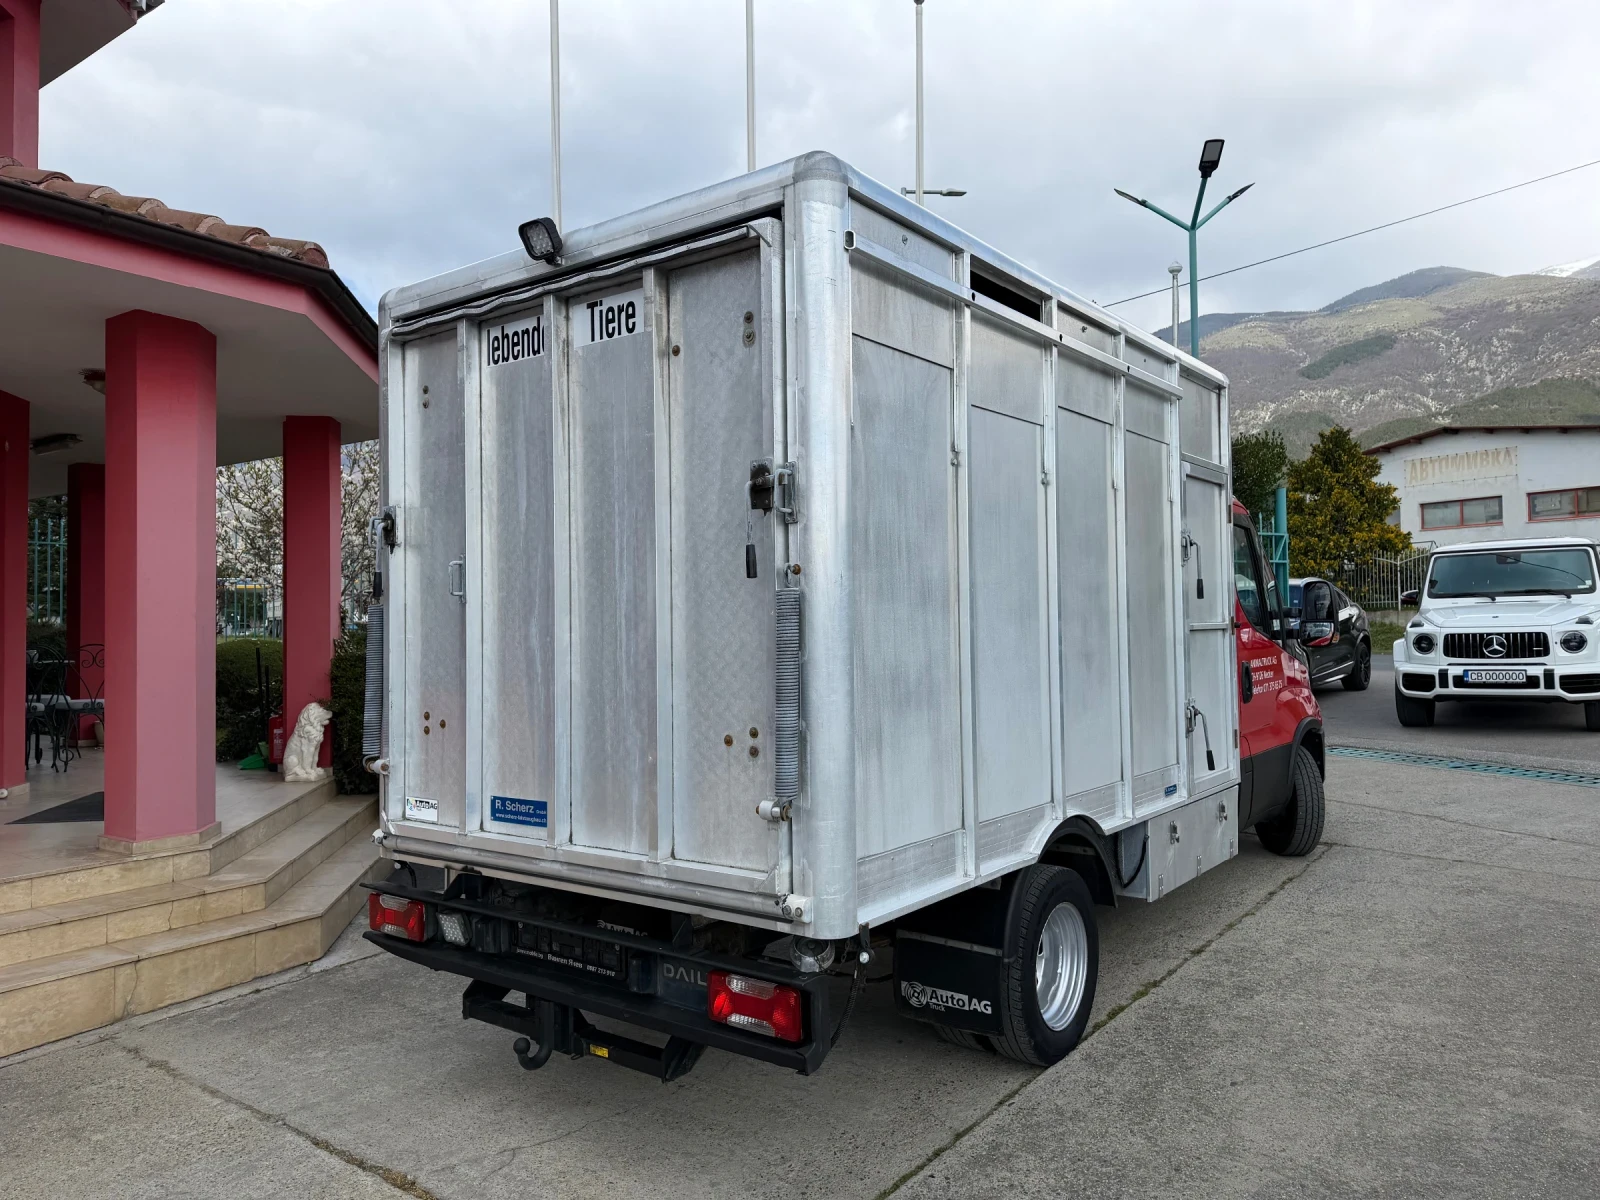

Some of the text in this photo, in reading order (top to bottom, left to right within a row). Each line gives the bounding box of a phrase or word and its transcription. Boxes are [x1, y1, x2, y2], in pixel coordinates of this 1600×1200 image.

[487, 300, 637, 367] lebend Tiere
[1408, 448, 1514, 485] АВТОМИВКА
[495, 799, 504, 809] R.
[505, 800, 535, 813] Scherz
[663, 962, 708, 986] DAIL
[928, 1002, 946, 1012] Truck
[929, 989, 992, 1014] Auto AG
